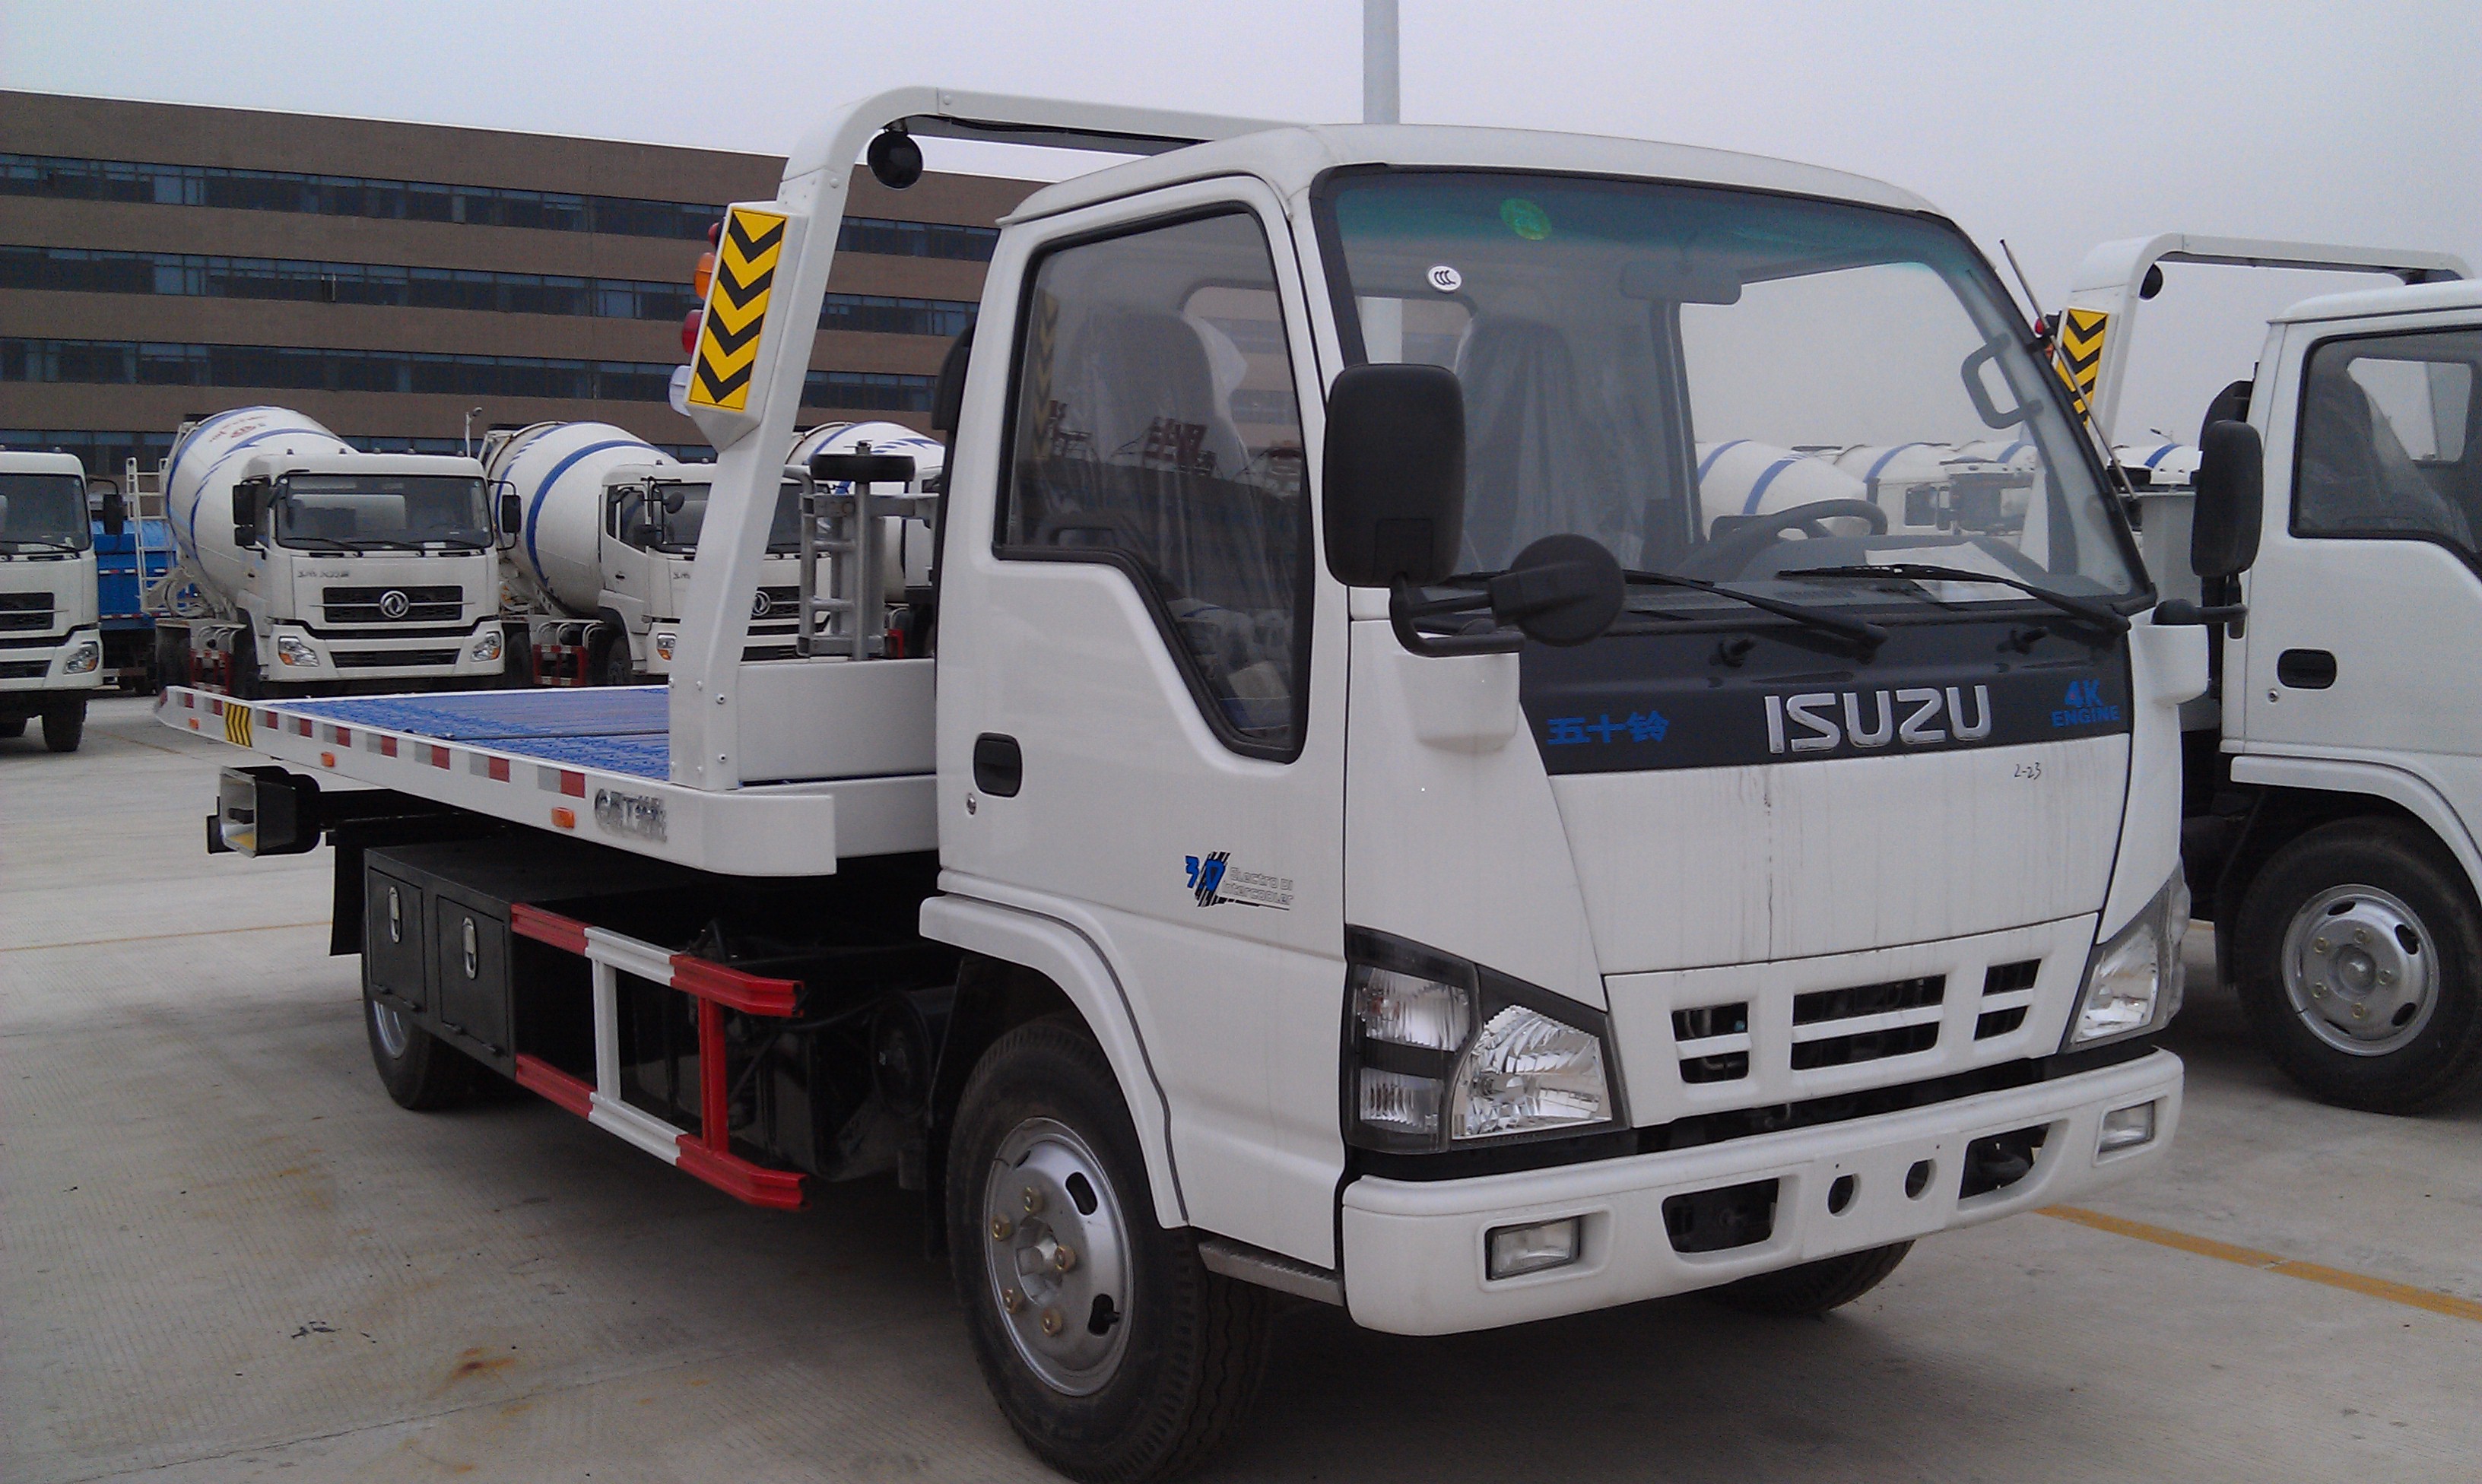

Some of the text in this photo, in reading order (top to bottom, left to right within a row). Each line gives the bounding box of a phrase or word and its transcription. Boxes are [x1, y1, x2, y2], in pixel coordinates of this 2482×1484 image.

[2065, 679, 2103, 708] 4K
[1547, 710, 1669, 745] 五十铃
[1764, 685, 1992, 753] ISUZU
[2051, 706, 2120, 728] ENGINE
